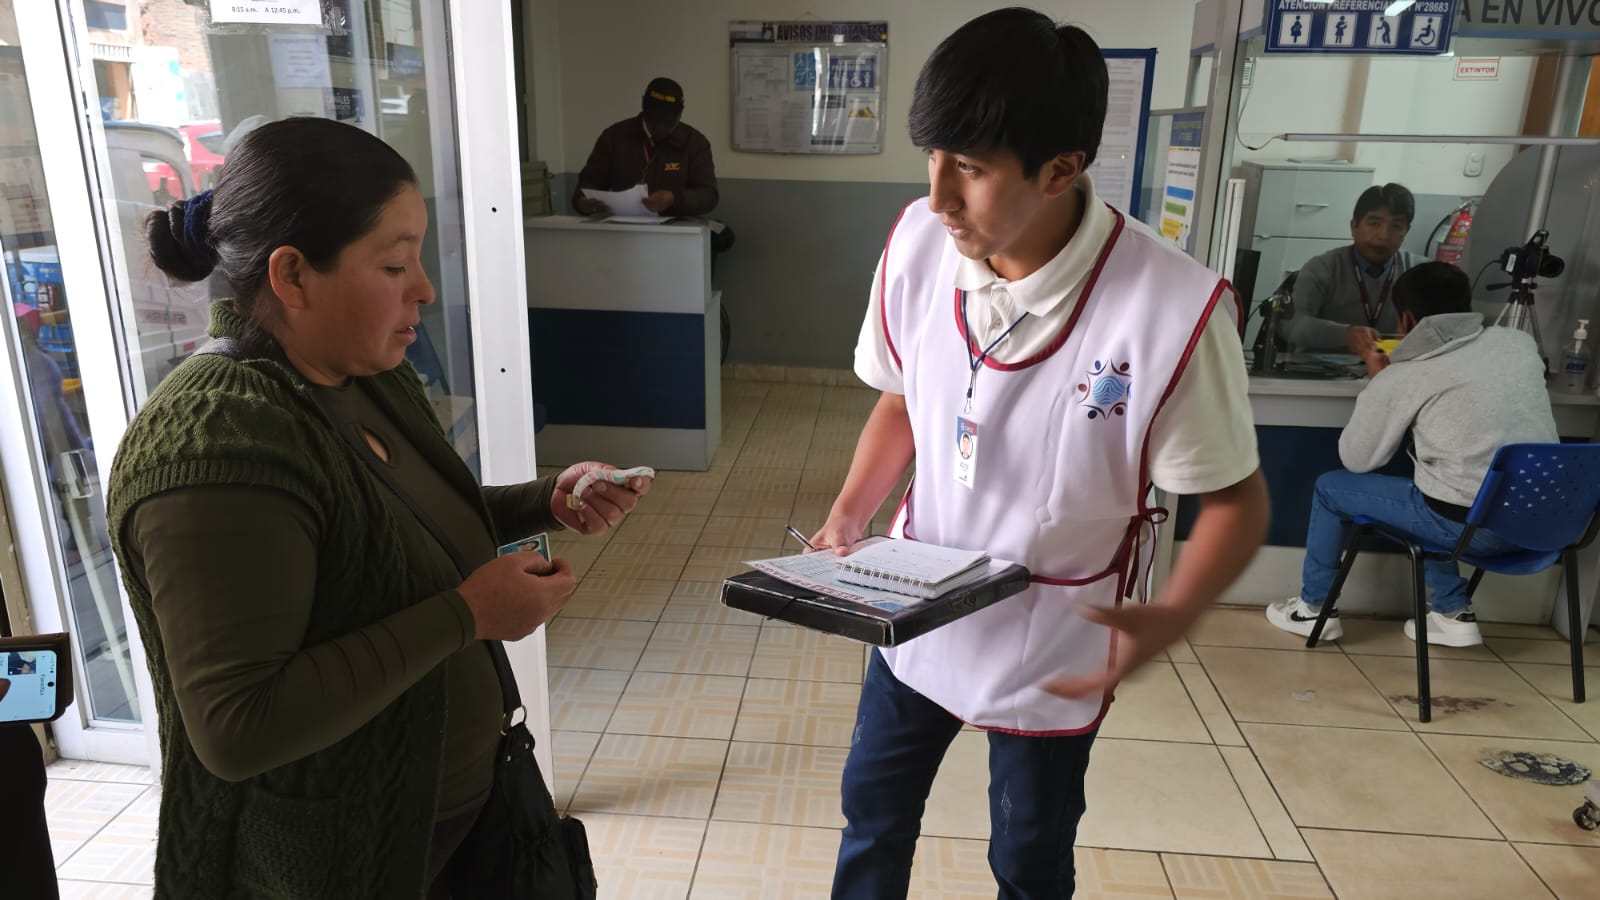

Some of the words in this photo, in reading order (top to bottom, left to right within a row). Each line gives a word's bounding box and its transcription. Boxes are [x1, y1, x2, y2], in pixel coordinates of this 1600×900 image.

[1327, 0, 1391, 11] PREFERENCIA
[1481, 0, 1524, 25] EN
[777, 24, 813, 41] AVISOS
[754, 563, 790, 580] PAGO
